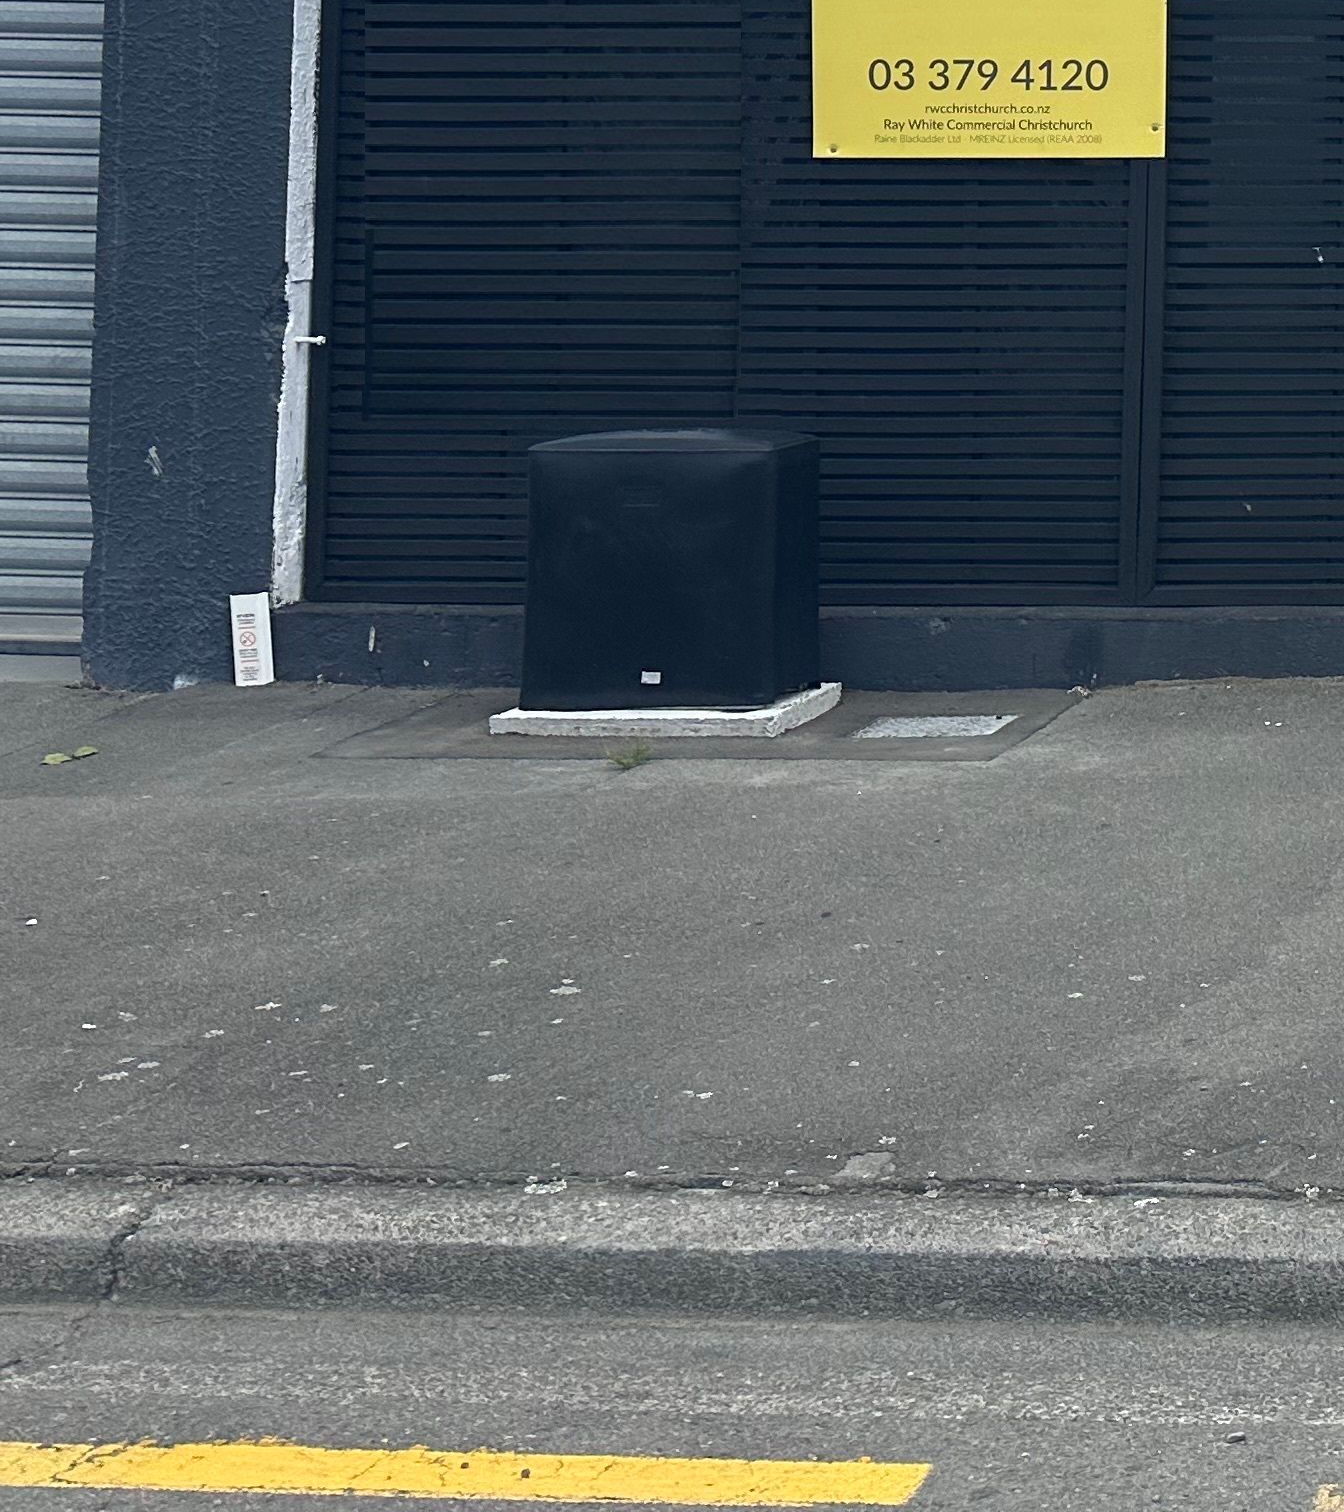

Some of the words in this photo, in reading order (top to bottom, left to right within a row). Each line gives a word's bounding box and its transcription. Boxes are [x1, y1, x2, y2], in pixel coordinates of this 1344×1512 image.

[868, 59, 915, 90] 03
[928, 59, 999, 90] 379
[1010, 59, 1109, 90] 4120
[925, 103, 1051, 115] rwcchristchurch.co.nz
[883, 119, 905, 132] Ray
[908, 119, 944, 131] White
[946, 119, 1016, 131] Commercial
[1018, 119, 1093, 131] Christchurch
